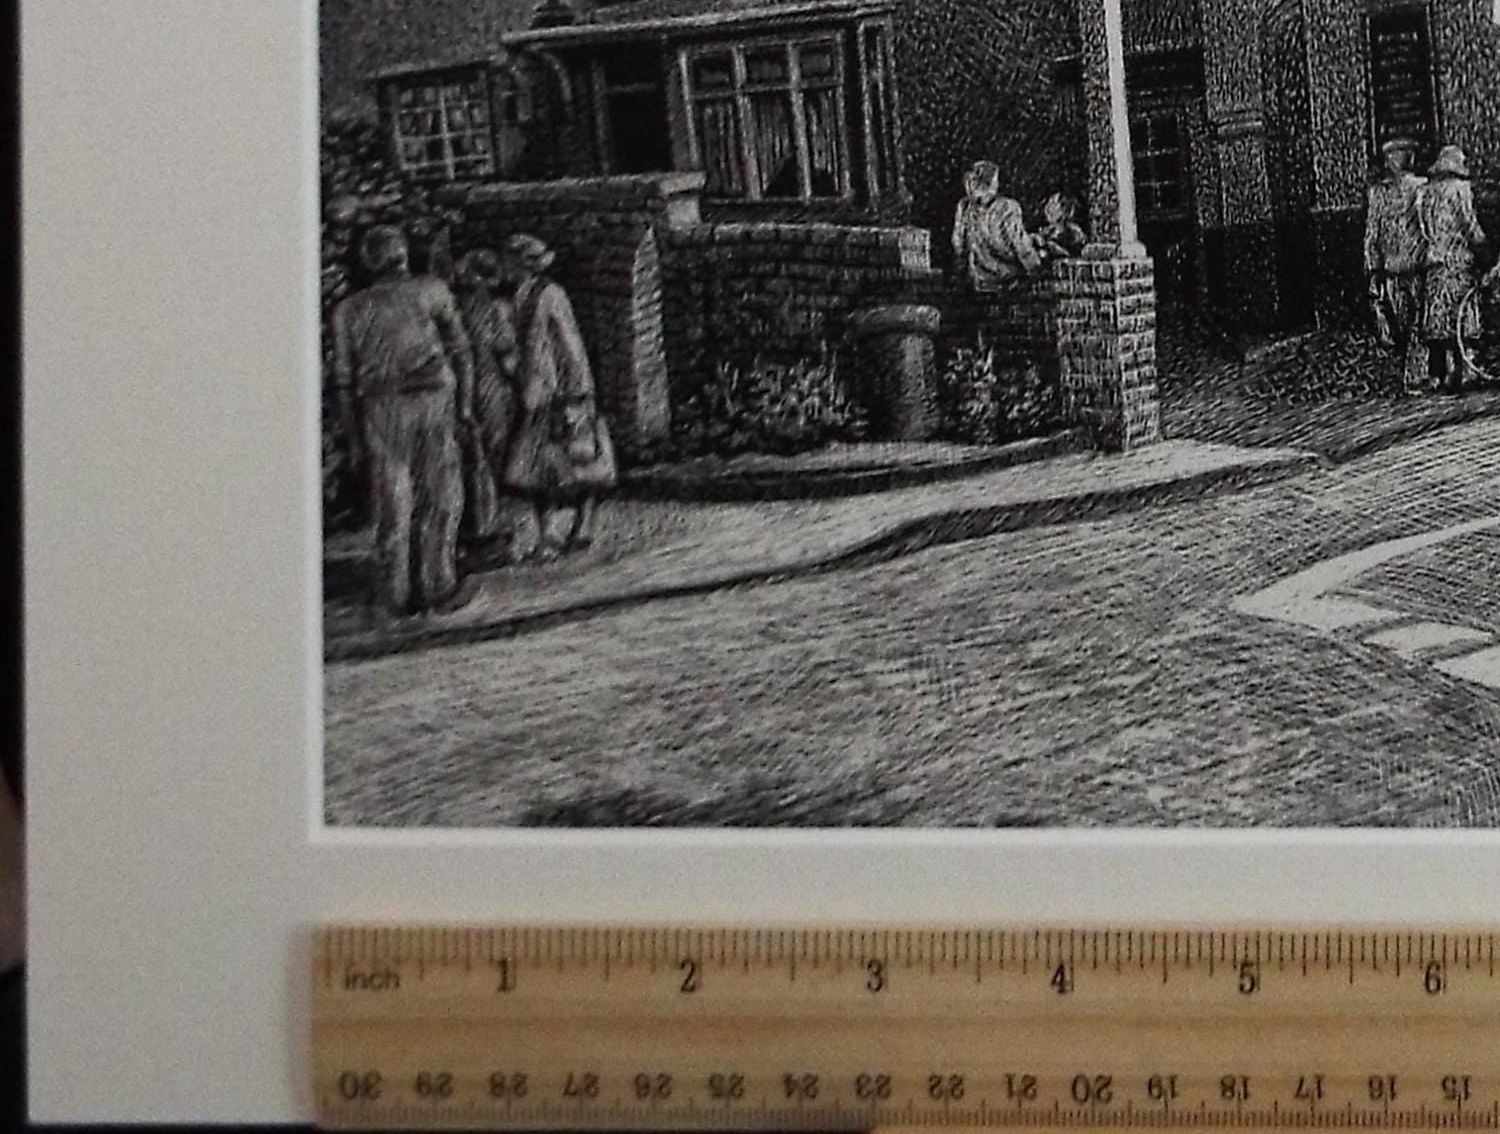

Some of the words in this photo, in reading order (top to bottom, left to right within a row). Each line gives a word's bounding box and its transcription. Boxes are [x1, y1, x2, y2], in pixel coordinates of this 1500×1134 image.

[343, 968, 400, 991] inch
[497, 959, 511, 991] 1
[681, 959, 696, 992] 2
[866, 960, 884, 992] 3
[1051, 963, 1069, 994] 4
[1238, 962, 1255, 994] 5
[1424, 961, 1441, 994] 6
[340, 1071, 382, 1101] 30
[416, 1072, 453, 1097] 29
[489, 1072, 528, 1097] 28
[562, 1074, 598, 1097] 27
[635, 1074, 673, 1100] 26
[709, 1074, 745, 1100] 25
[782, 1074, 818, 1098] 24
[855, 1074, 892, 1100] 23
[929, 1075, 964, 1100] 22
[1006, 1075, 1037, 1100] 21
[1072, 1075, 1113, 1103] 20
[1148, 1075, 1179, 1100] 19
[1220, 1077, 1249, 1100] 18
[1295, 1077, 1325, 1100] 17
[1368, 1075, 1397, 1101] 16
[1442, 1075, 1471, 1101] 15
